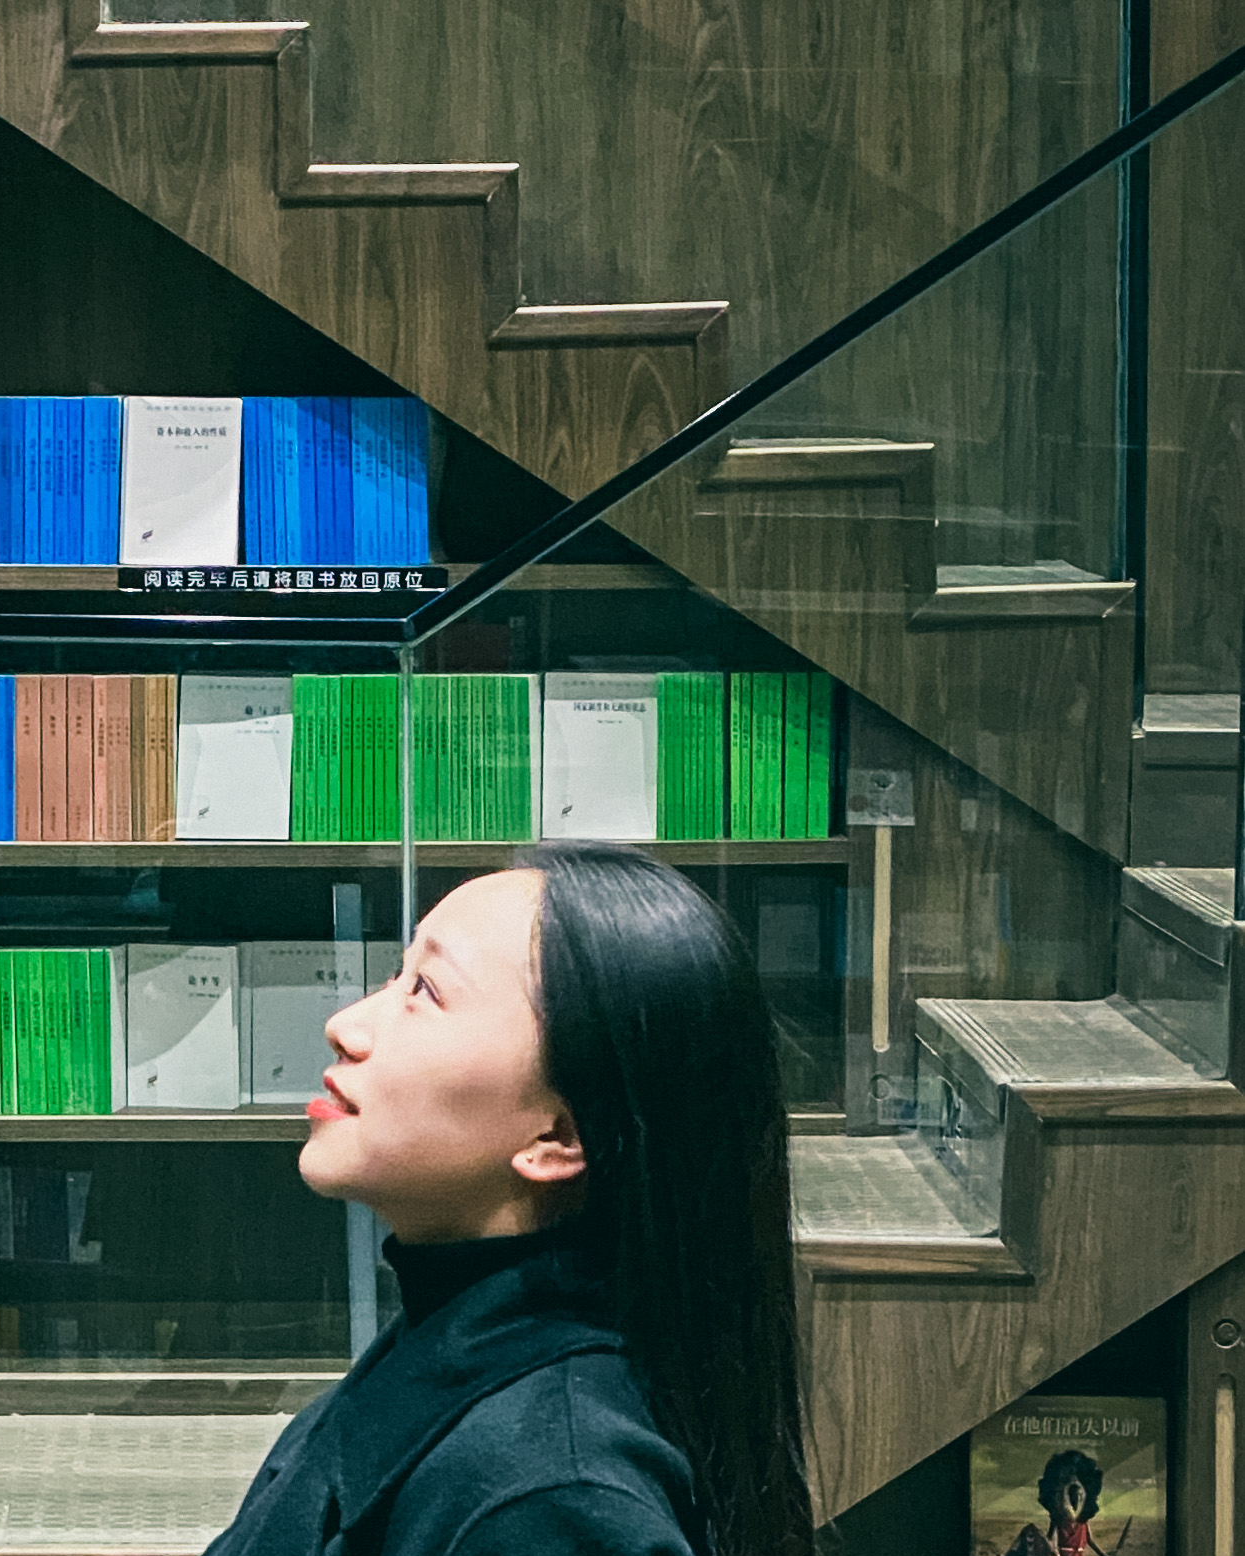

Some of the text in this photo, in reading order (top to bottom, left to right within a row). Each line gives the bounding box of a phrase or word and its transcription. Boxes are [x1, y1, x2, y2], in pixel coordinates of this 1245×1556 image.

[156, 426, 227, 437] 资本和收入的性质
[143, 569, 424, 589] 阅读完毕后请将图书放回原位
[1003, 1415, 1141, 1437] 在他们消失以前
